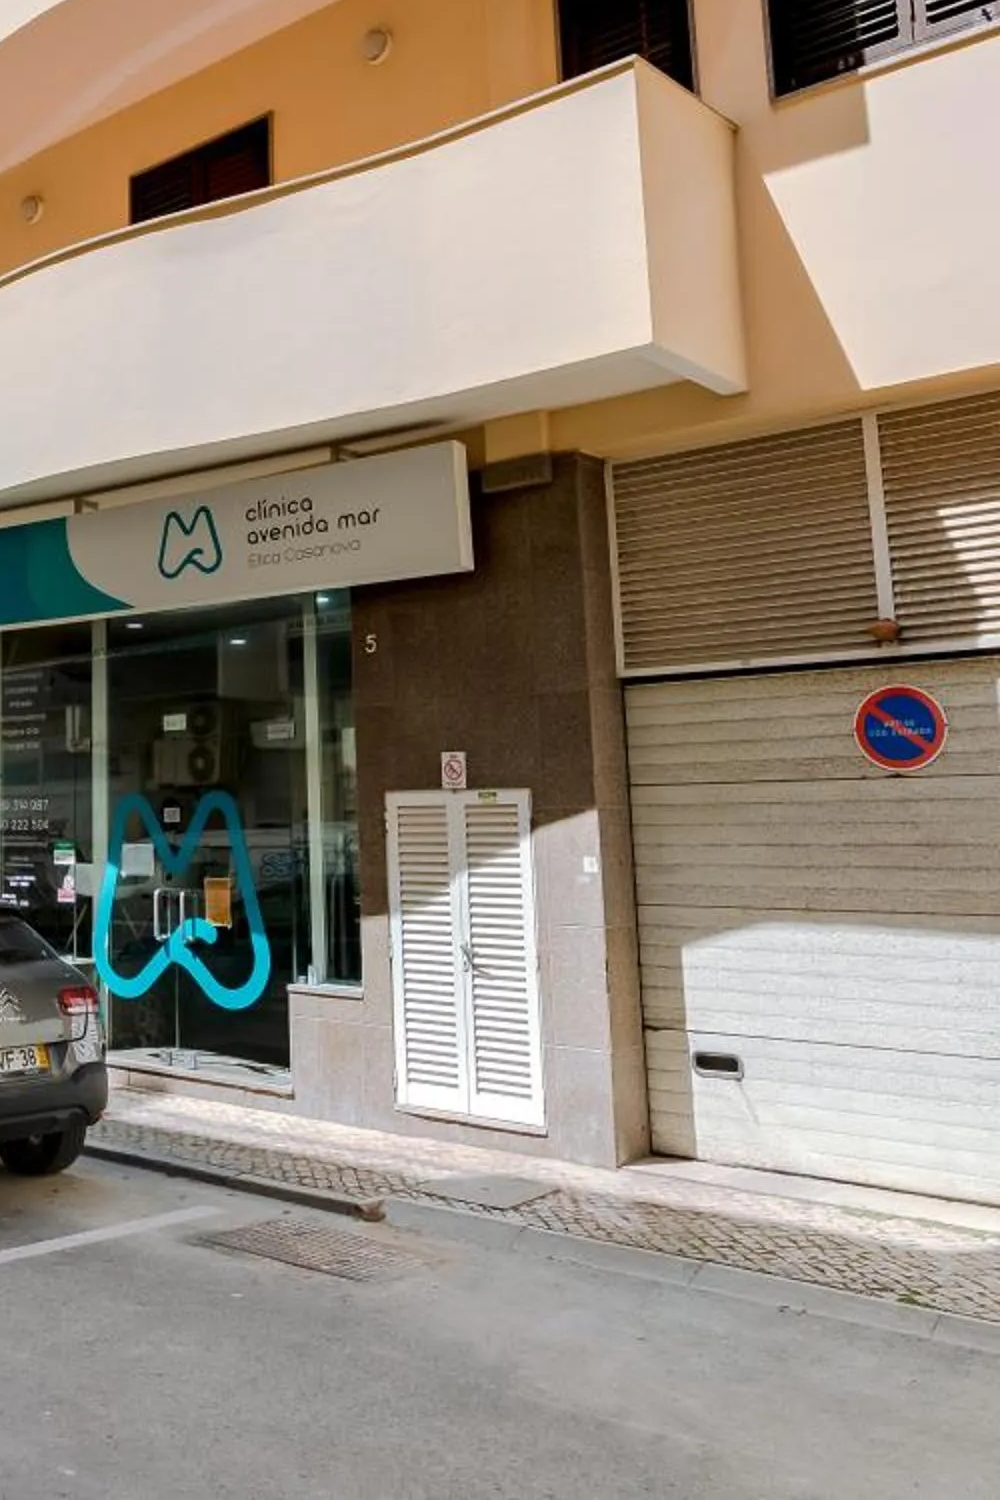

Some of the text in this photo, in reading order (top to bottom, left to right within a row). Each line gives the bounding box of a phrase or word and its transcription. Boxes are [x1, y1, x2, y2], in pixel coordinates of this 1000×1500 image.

[247, 508, 380, 545] avenida mar
[365, 634, 377, 653] 5
